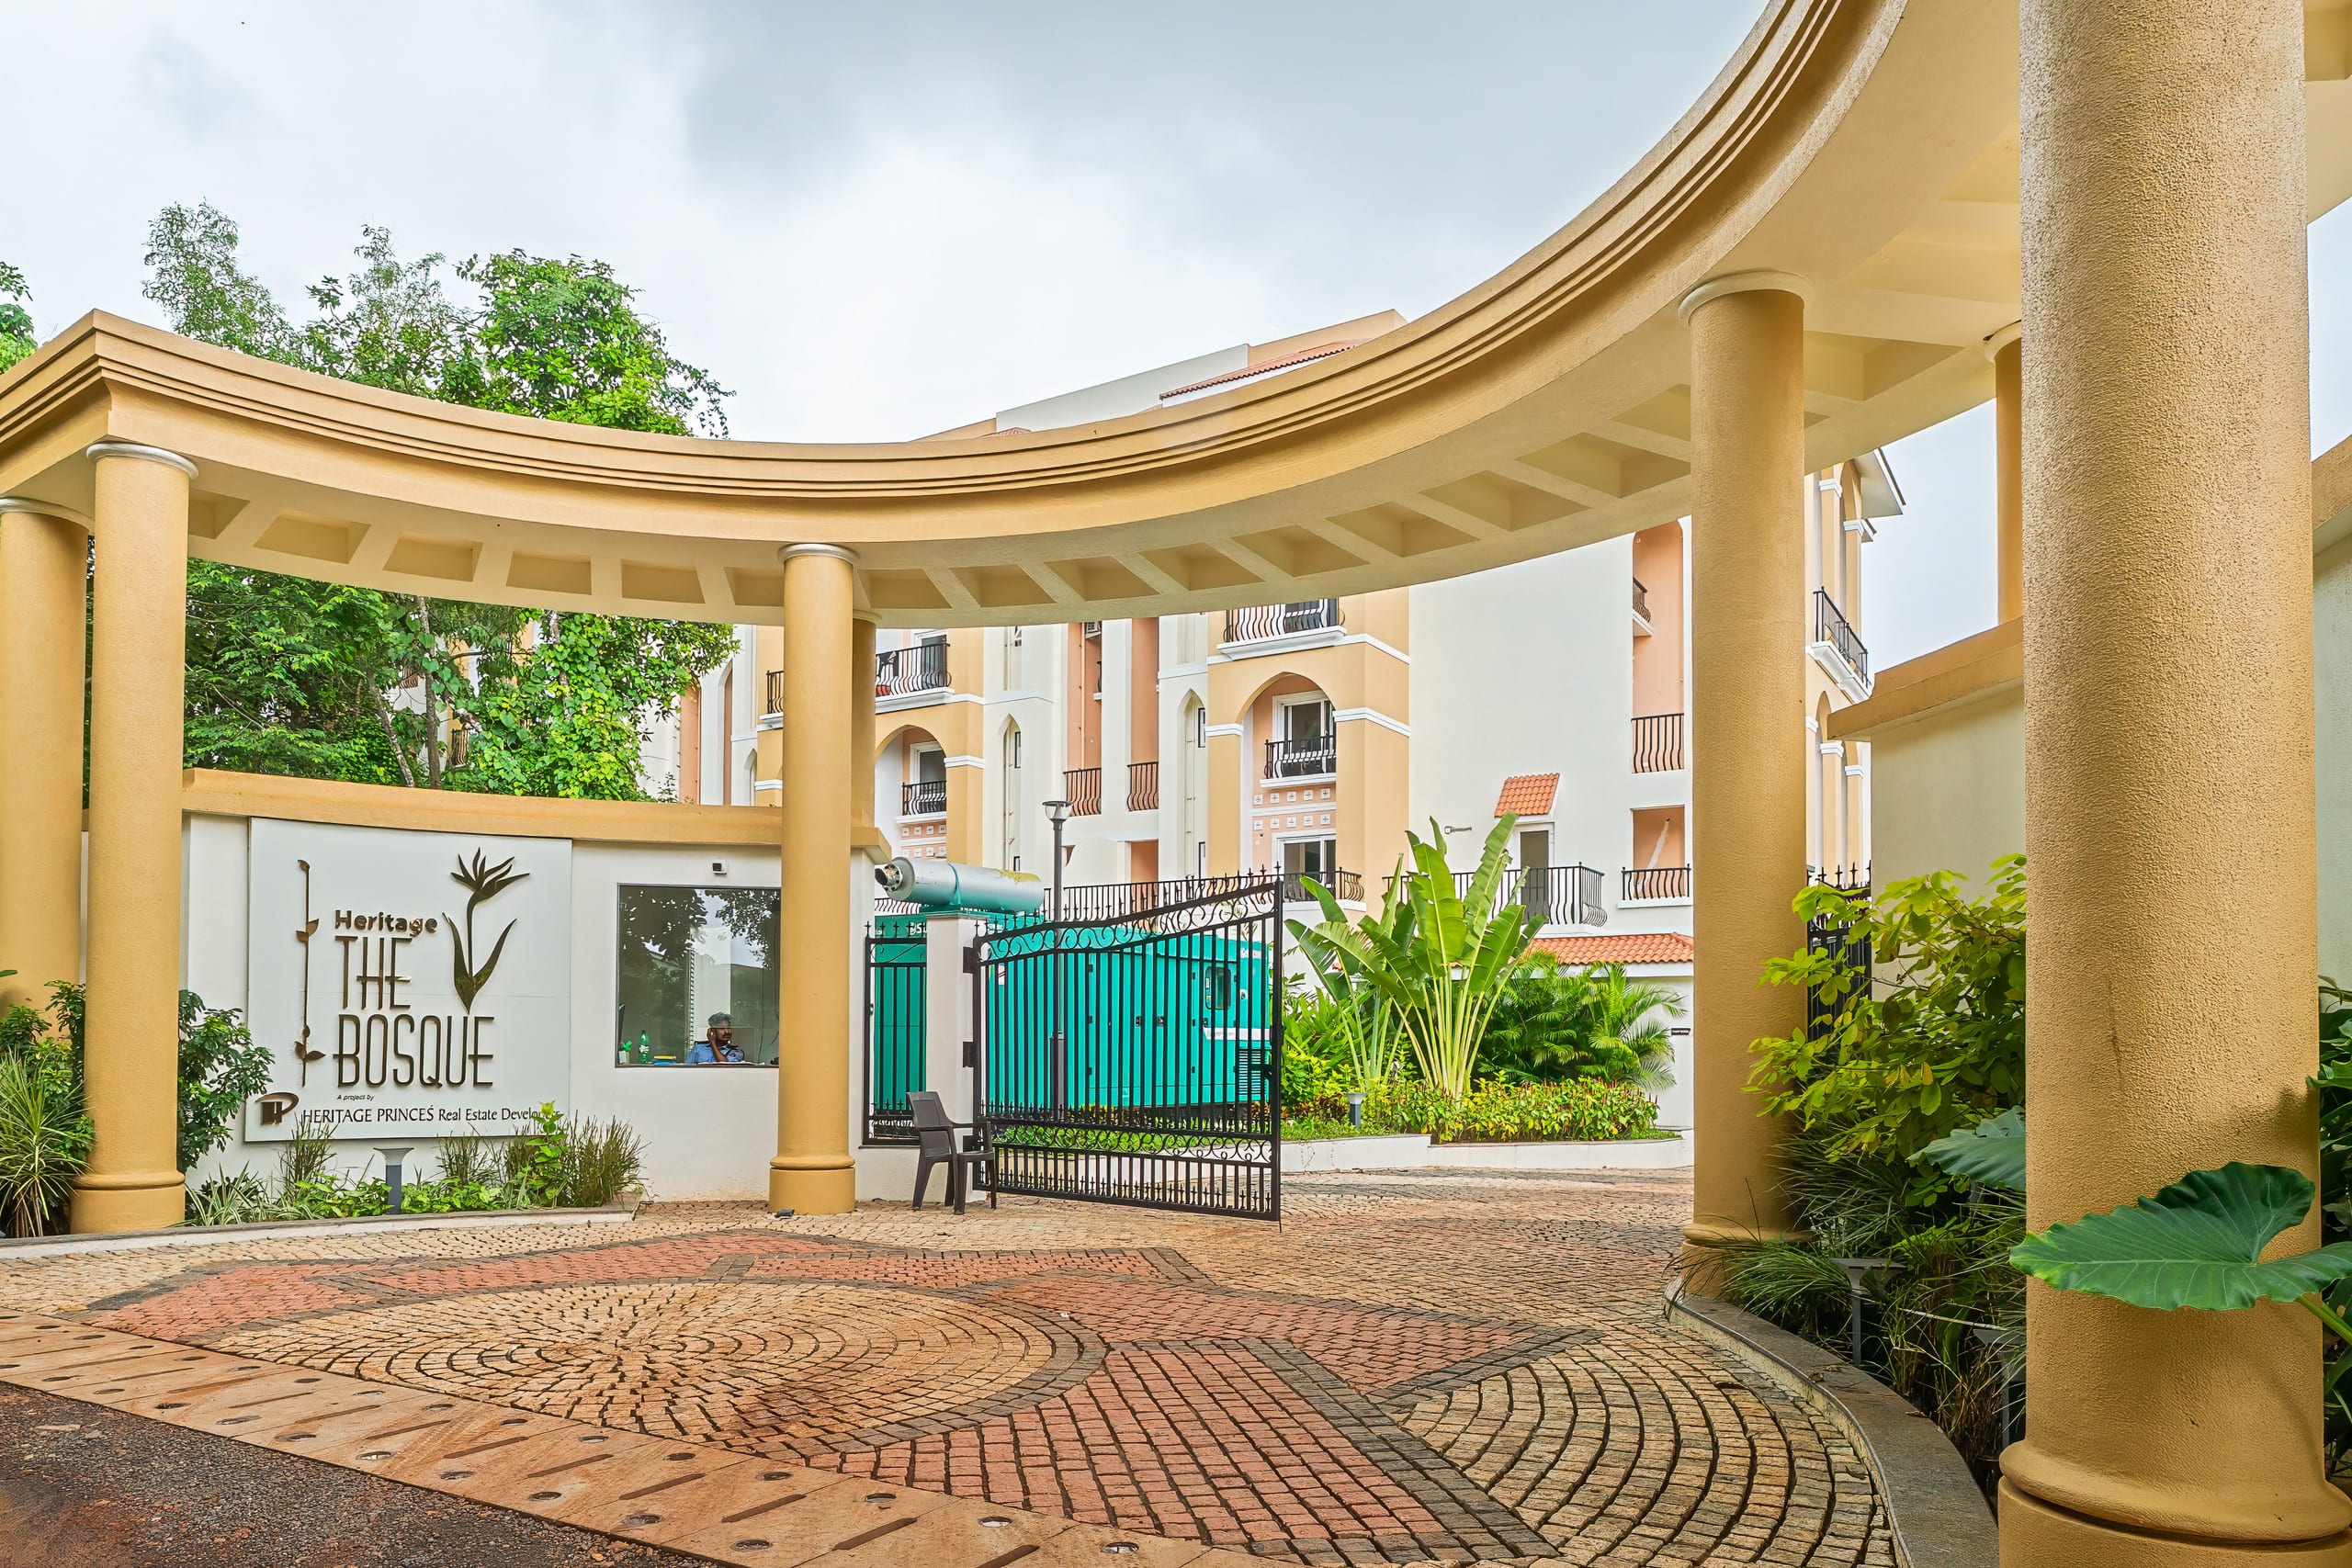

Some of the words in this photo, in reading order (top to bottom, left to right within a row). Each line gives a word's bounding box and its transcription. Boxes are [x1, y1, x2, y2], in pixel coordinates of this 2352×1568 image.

[334, 909, 438, 937] Heritage
[334, 935, 413, 1010] THE
[333, 1013, 495, 1089] BOSQUE
[303, 1109, 373, 1123] HERITAGE
[438, 1108, 461, 1122] Real
[465, 1108, 498, 1121] Estate
